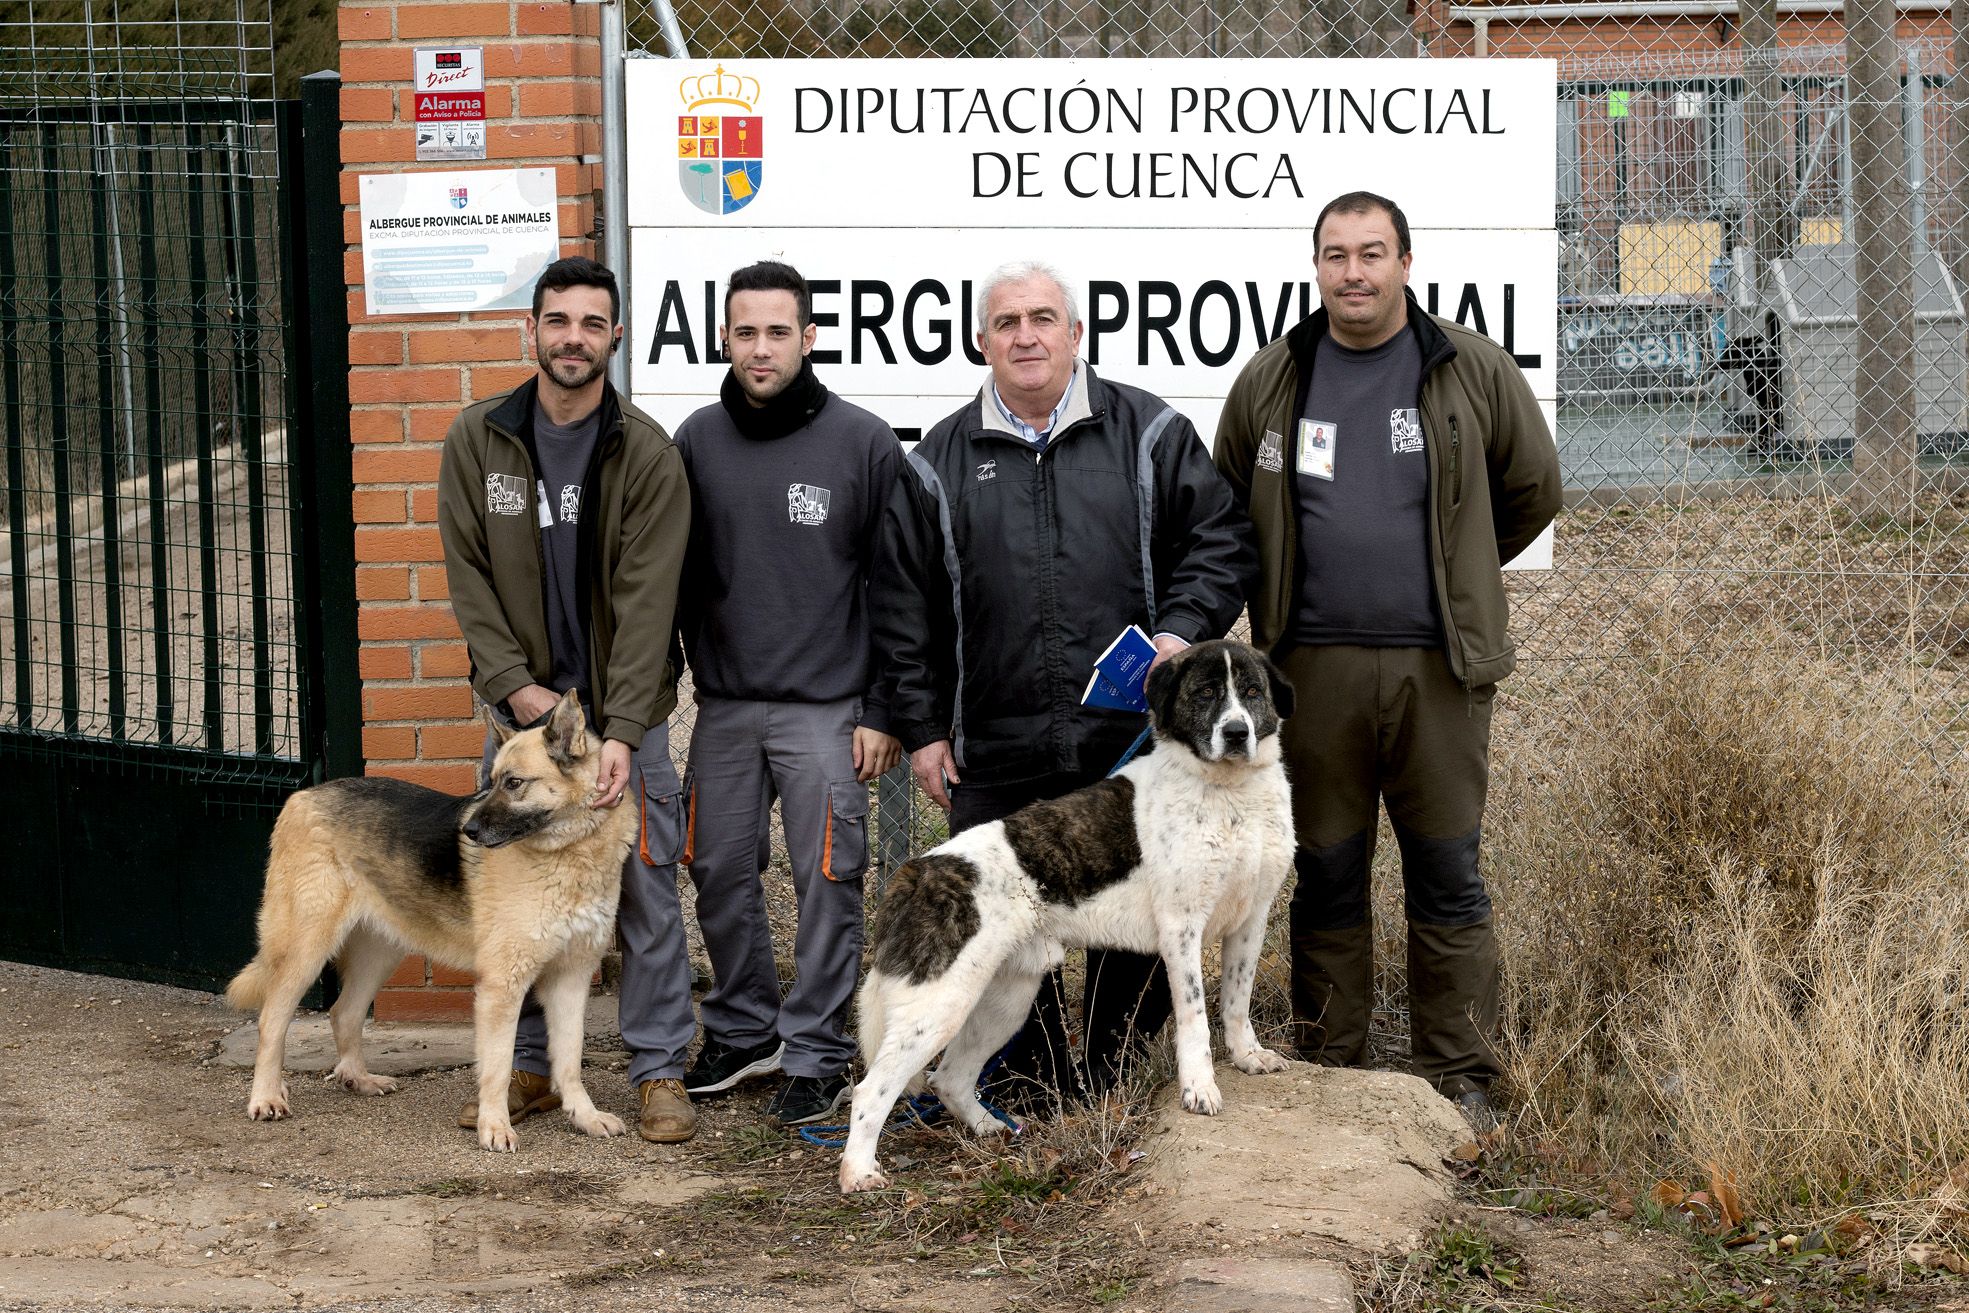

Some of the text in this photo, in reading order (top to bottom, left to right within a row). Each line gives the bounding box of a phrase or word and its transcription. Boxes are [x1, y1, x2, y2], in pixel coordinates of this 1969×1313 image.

[425, 67, 475, 88] Direct
[419, 96, 481, 110] Alarma
[794, 78, 1506, 135] DIPUTACIÓN PROVINCIAL
[972, 151, 1304, 199] DE CUENCA
[369, 212, 552, 230] ALBERGUE PROVINCIAL DE ANIMALES
[401, 228, 450, 238] DIPUTACIÓN
[452, 227, 501, 236] PROVINCIAL
[502, 226, 514, 234] DE
[515, 225, 550, 233] CUENCA
[647, 279, 996, 366] ALERGU
[1088, 279, 1542, 369] PROVAL
